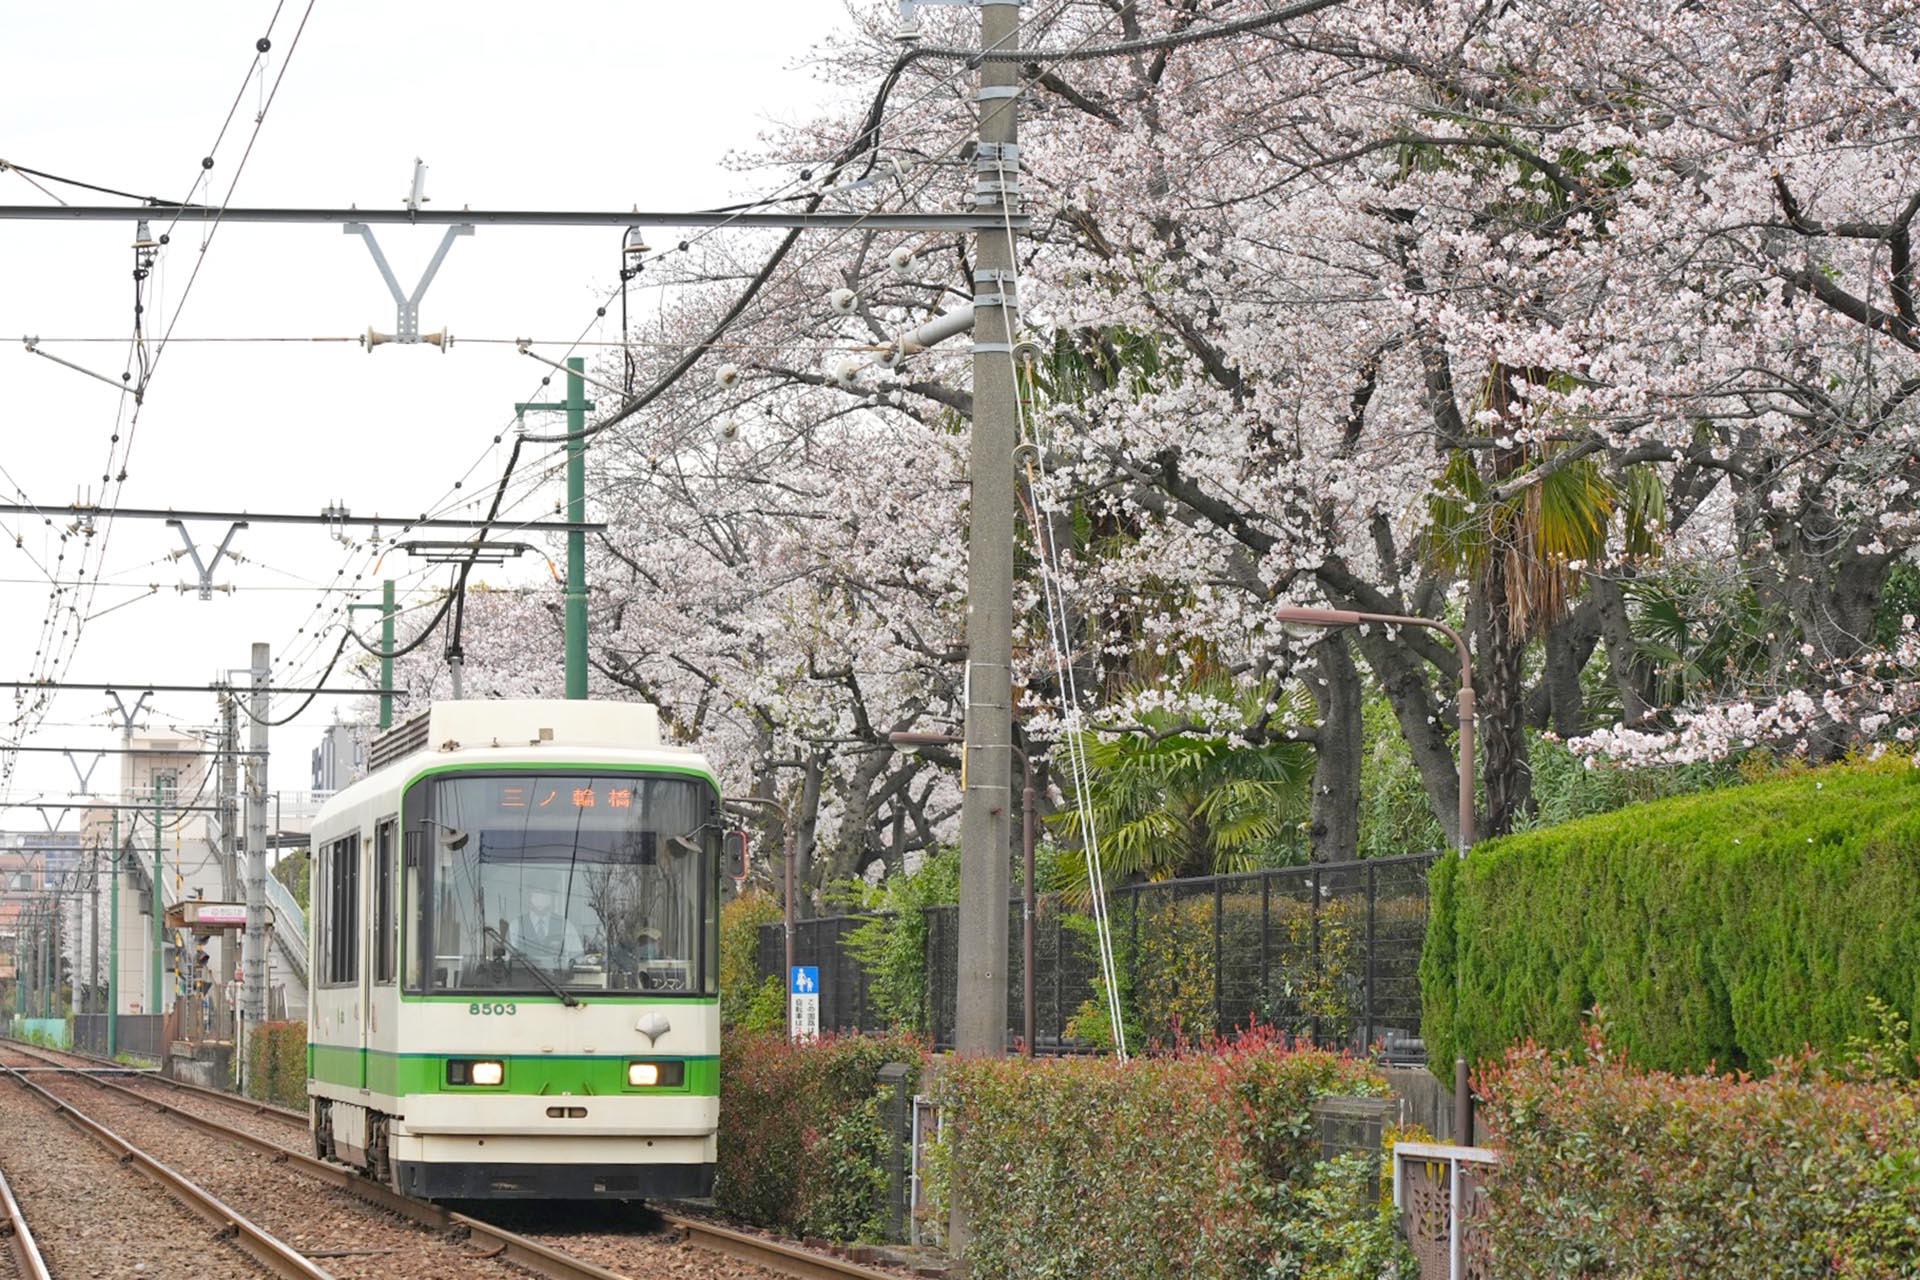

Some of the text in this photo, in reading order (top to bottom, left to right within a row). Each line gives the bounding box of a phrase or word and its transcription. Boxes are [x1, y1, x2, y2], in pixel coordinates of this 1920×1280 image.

[501, 788, 630, 807] 三ノ輪橋
[469, 1003, 517, 1016] 8503
